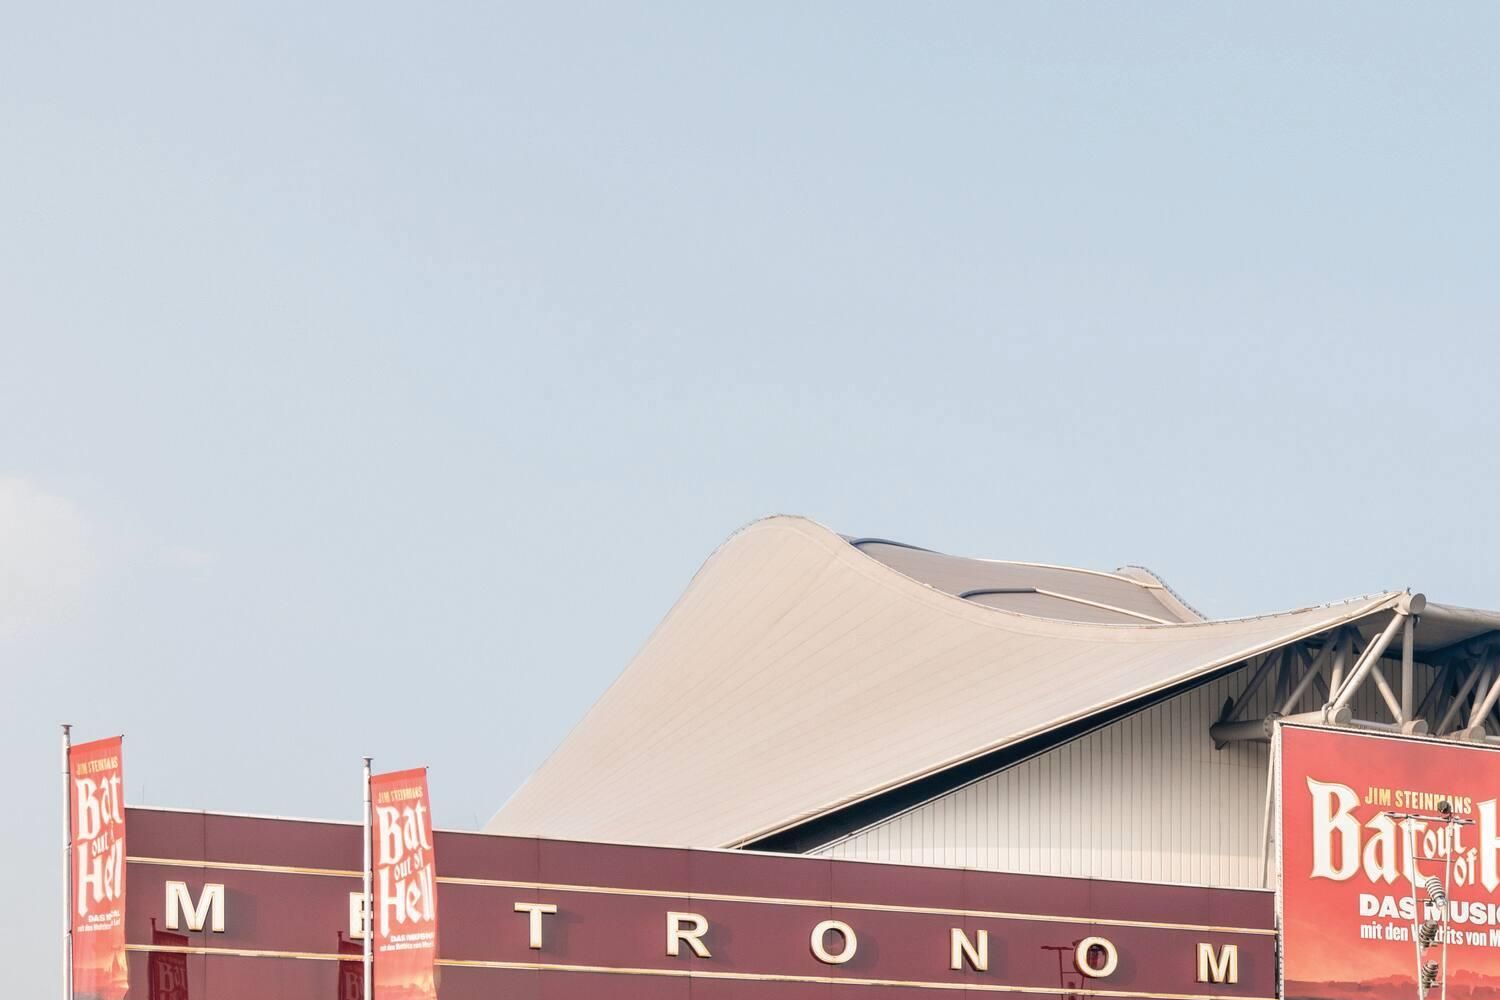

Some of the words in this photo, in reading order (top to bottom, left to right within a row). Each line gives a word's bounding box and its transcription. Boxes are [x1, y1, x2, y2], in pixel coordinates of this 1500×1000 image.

[75, 774, 123, 840] Bat
[376, 800, 432, 865] Bat
[1306, 775, 1441, 889] Bat
[1423, 816, 1467, 859] out
[1453, 847, 1477, 887] of
[1364, 786, 1392, 806] JIM
[1395, 790, 1472, 814] STEINMANS
[379, 864, 435, 938] Hell
[1360, 893, 1416, 920] DAS
[1360, 921, 1383, 940] mit
[1385, 922, 1409, 942] den
[1465, 931, 1488, 947] von
